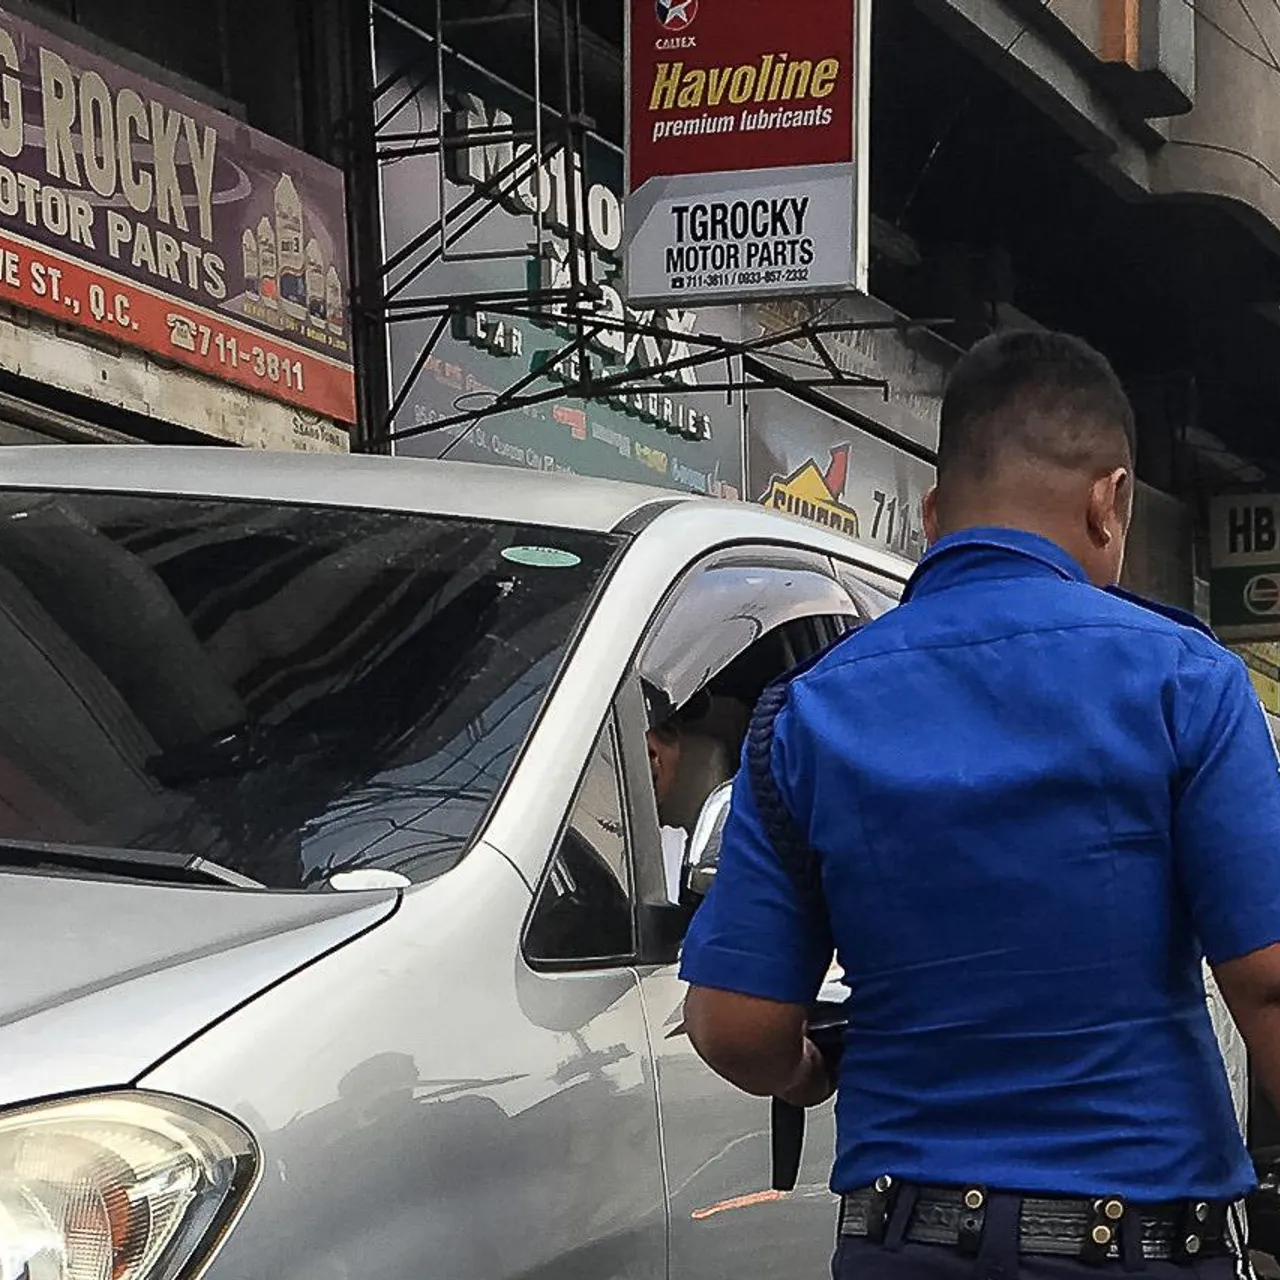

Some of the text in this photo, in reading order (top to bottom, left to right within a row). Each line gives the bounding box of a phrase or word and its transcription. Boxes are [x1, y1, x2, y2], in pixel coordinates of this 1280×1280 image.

[654, 36, 697, 50] CALTEX
[647, 52, 841, 111] Havoline
[39, 46, 217, 243] ROCKY
[652, 104, 834, 143] premium lubricants
[670, 196, 810, 244] TGROCKY
[106, 209, 227, 300] PARTS
[665, 238, 815, 275] MOTOR PARTS
[89, 283, 140, 332] Q.C.
[196, 326, 305, 393] 711-3811
